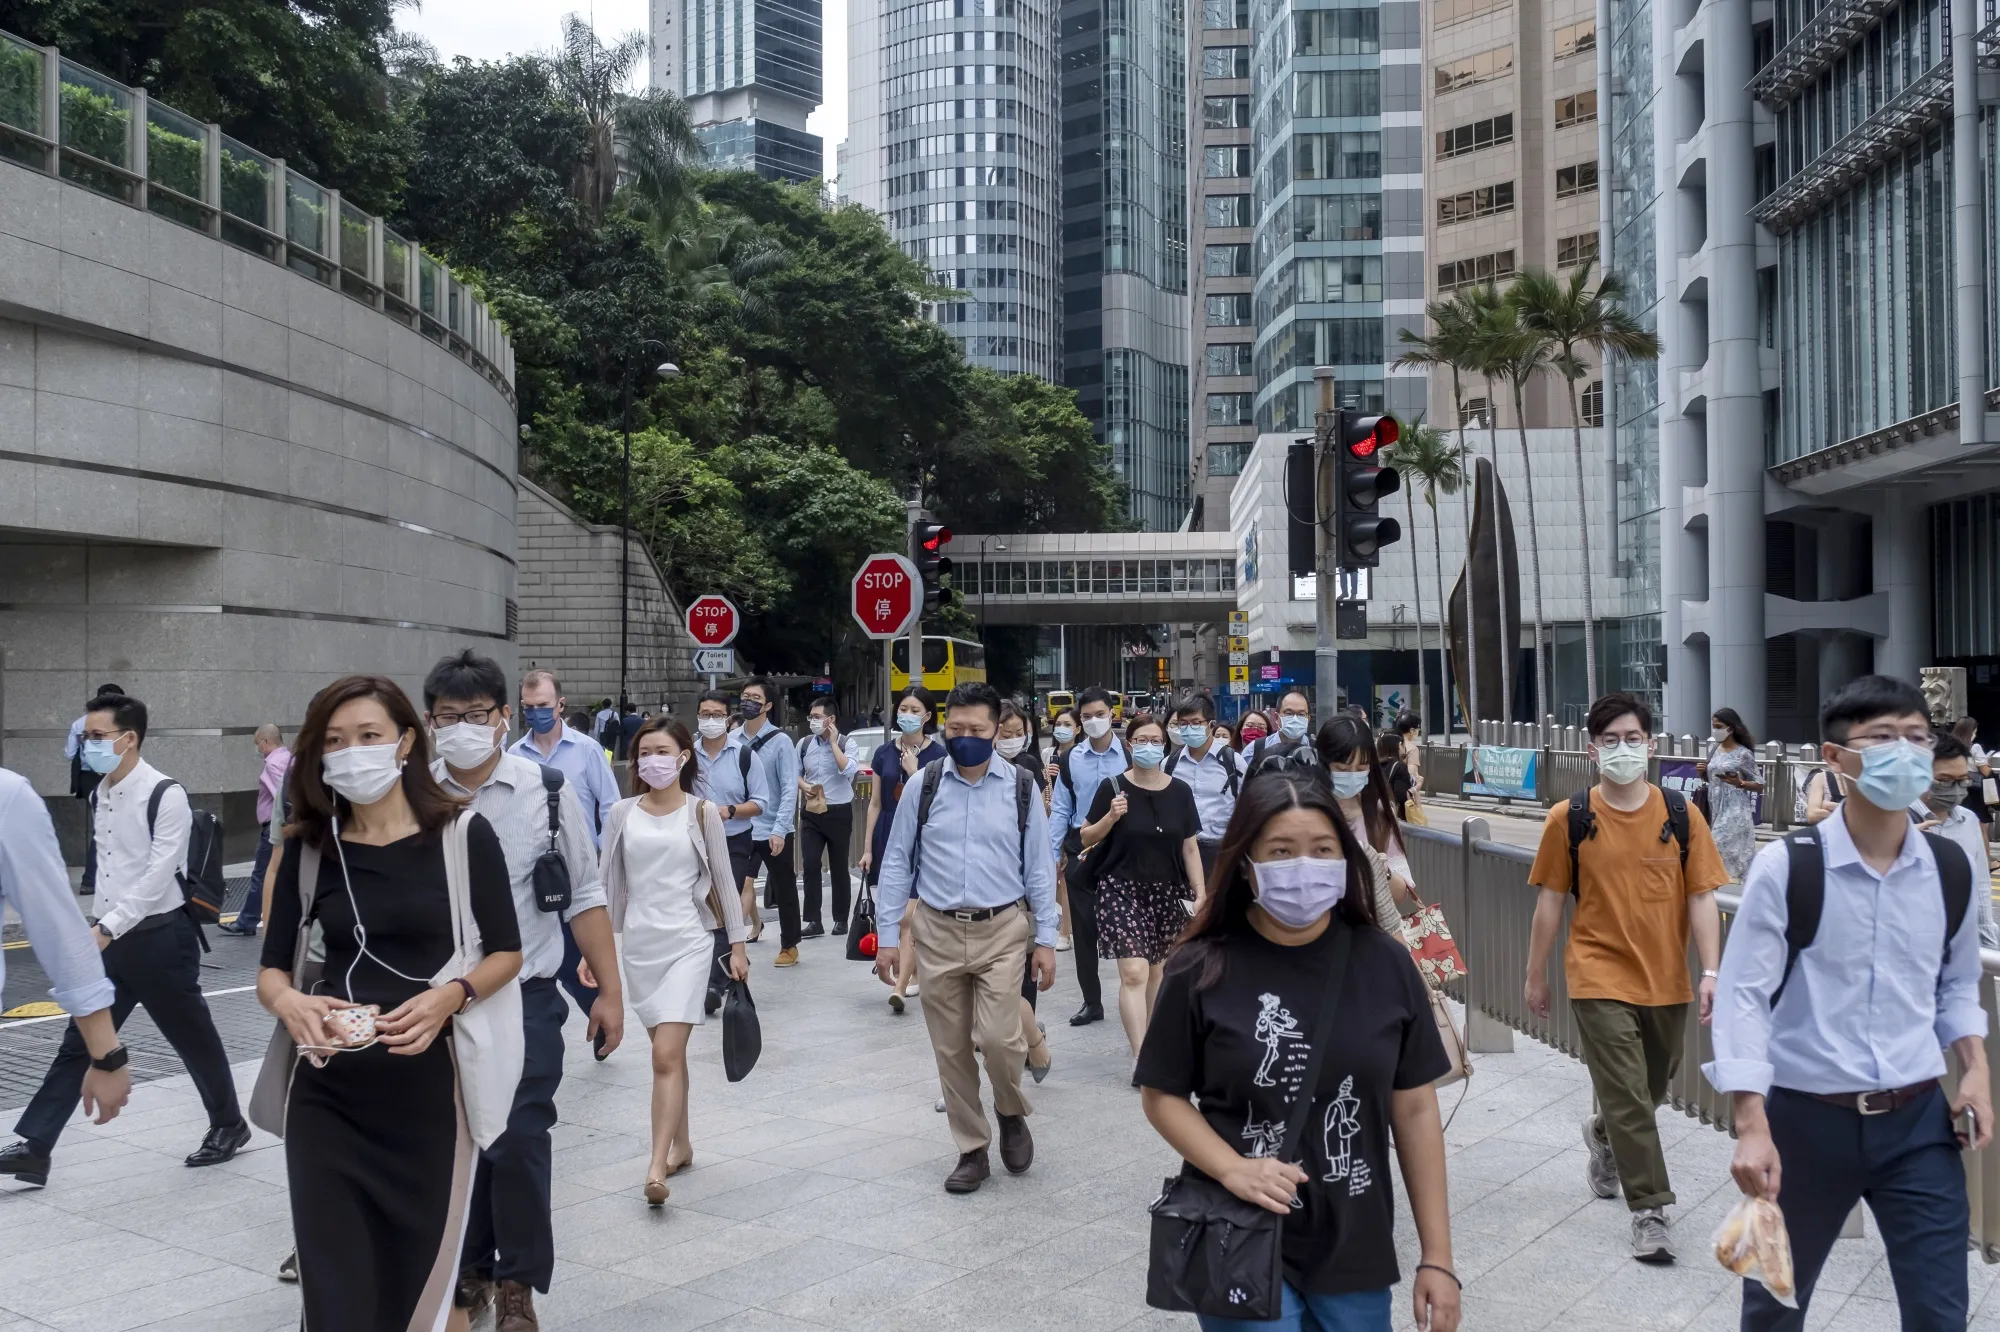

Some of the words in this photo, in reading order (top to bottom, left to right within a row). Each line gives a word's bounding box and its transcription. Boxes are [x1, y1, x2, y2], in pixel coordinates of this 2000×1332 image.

[864, 572, 903, 589] STOP
[695, 606, 727, 617] STOP
[874, 598, 891, 621] 停
[704, 622, 718, 637] 停
[545, 894, 562, 903] PLUS
